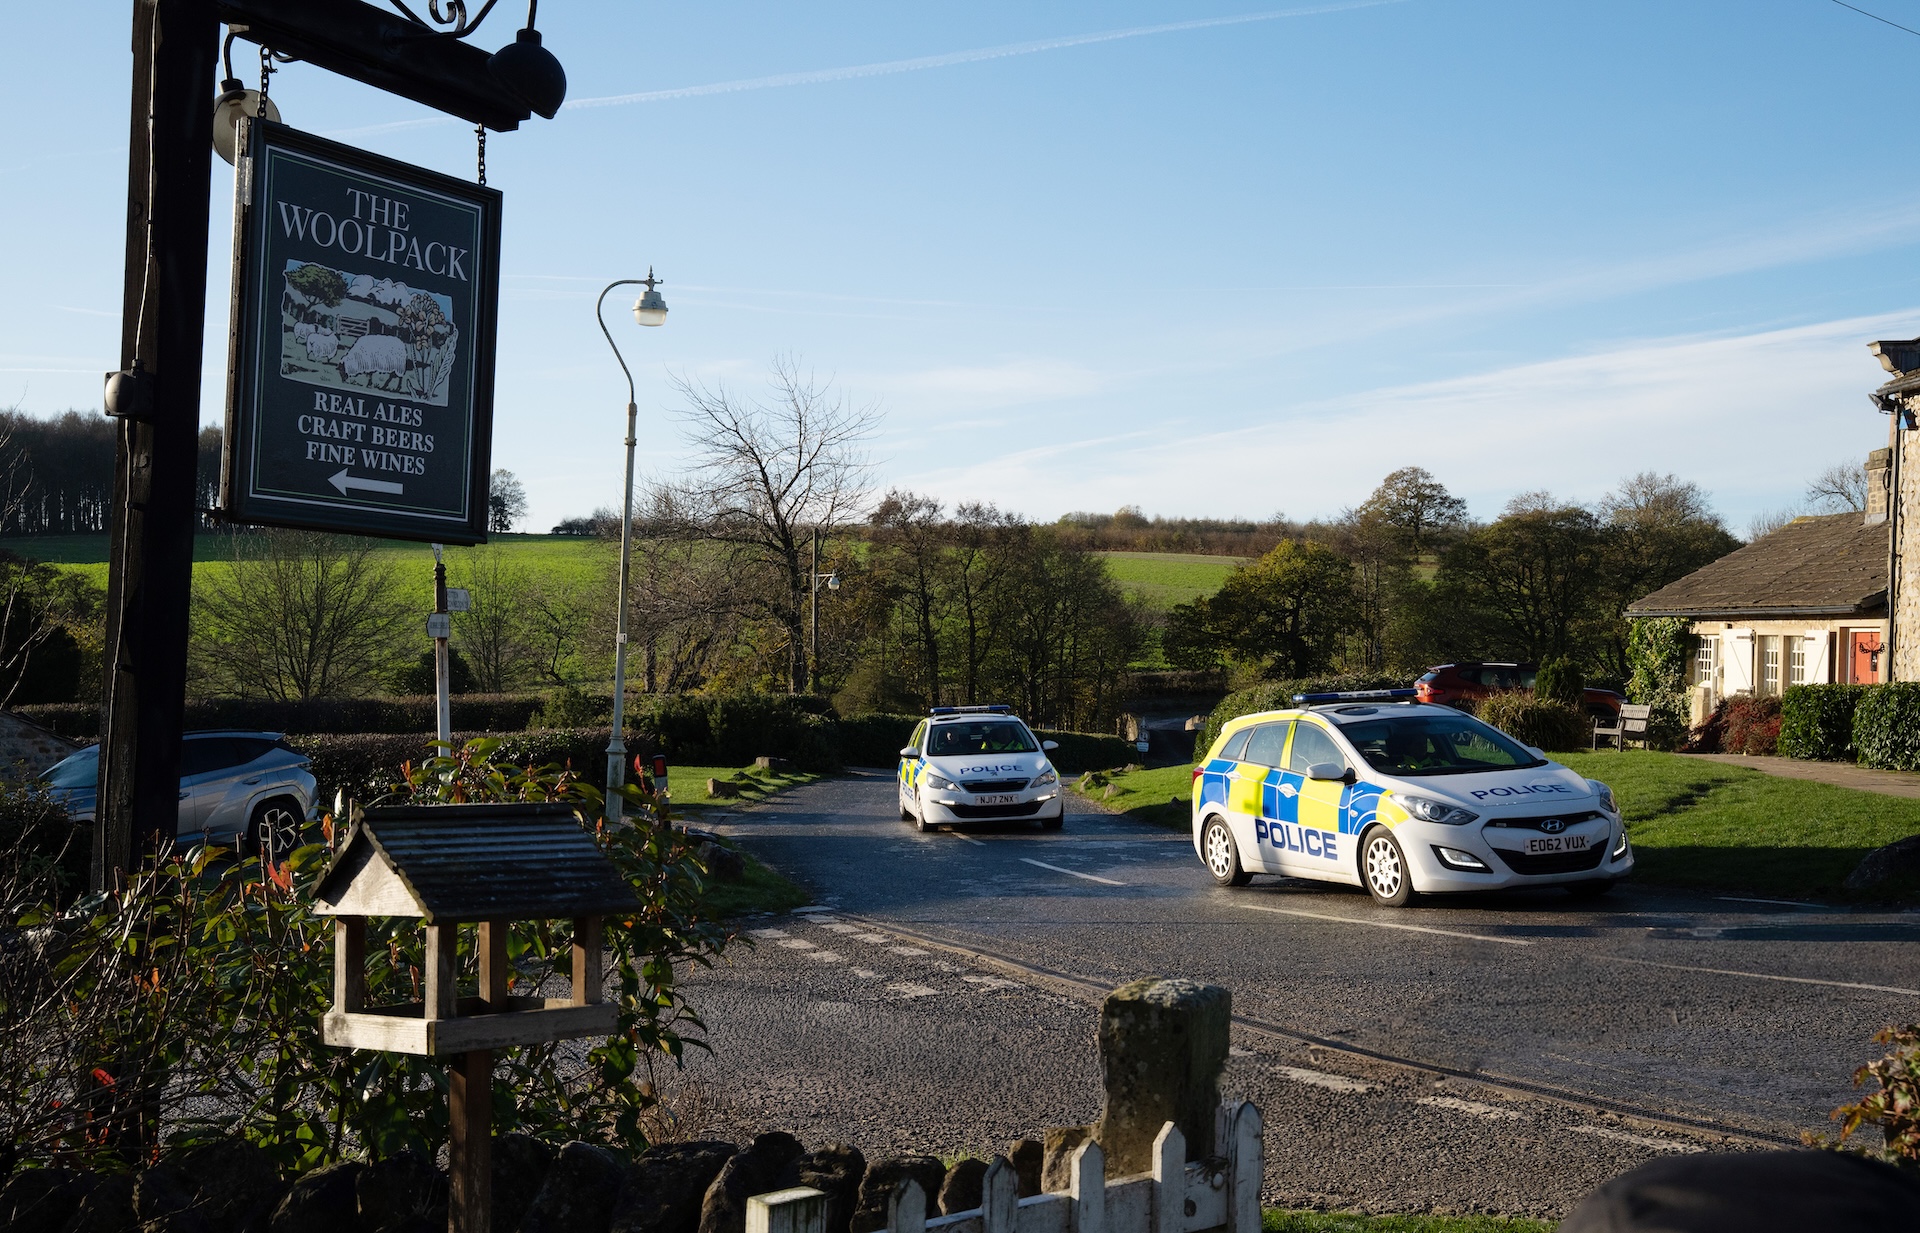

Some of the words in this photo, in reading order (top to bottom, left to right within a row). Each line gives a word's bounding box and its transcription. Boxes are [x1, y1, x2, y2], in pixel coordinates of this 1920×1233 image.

[346, 187, 410, 231] THE
[277, 201, 468, 281] WOOLPACK
[313, 391, 369, 418] REAL
[373, 400, 423, 427] ALES
[297, 415, 366, 443] CRAFT
[370, 425, 435, 452] BEERS
[305, 441, 356, 467] FINE
[360, 449, 425, 475] WINES
[960, 764, 1024, 774] POLICE
[980, 795, 997, 804] NJ17
[999, 795, 1014, 803] ZNX
[1470, 784, 1572, 800] POLICE
[1255, 818, 1338, 861] POLICE
[1564, 835, 1586, 849] VUX
